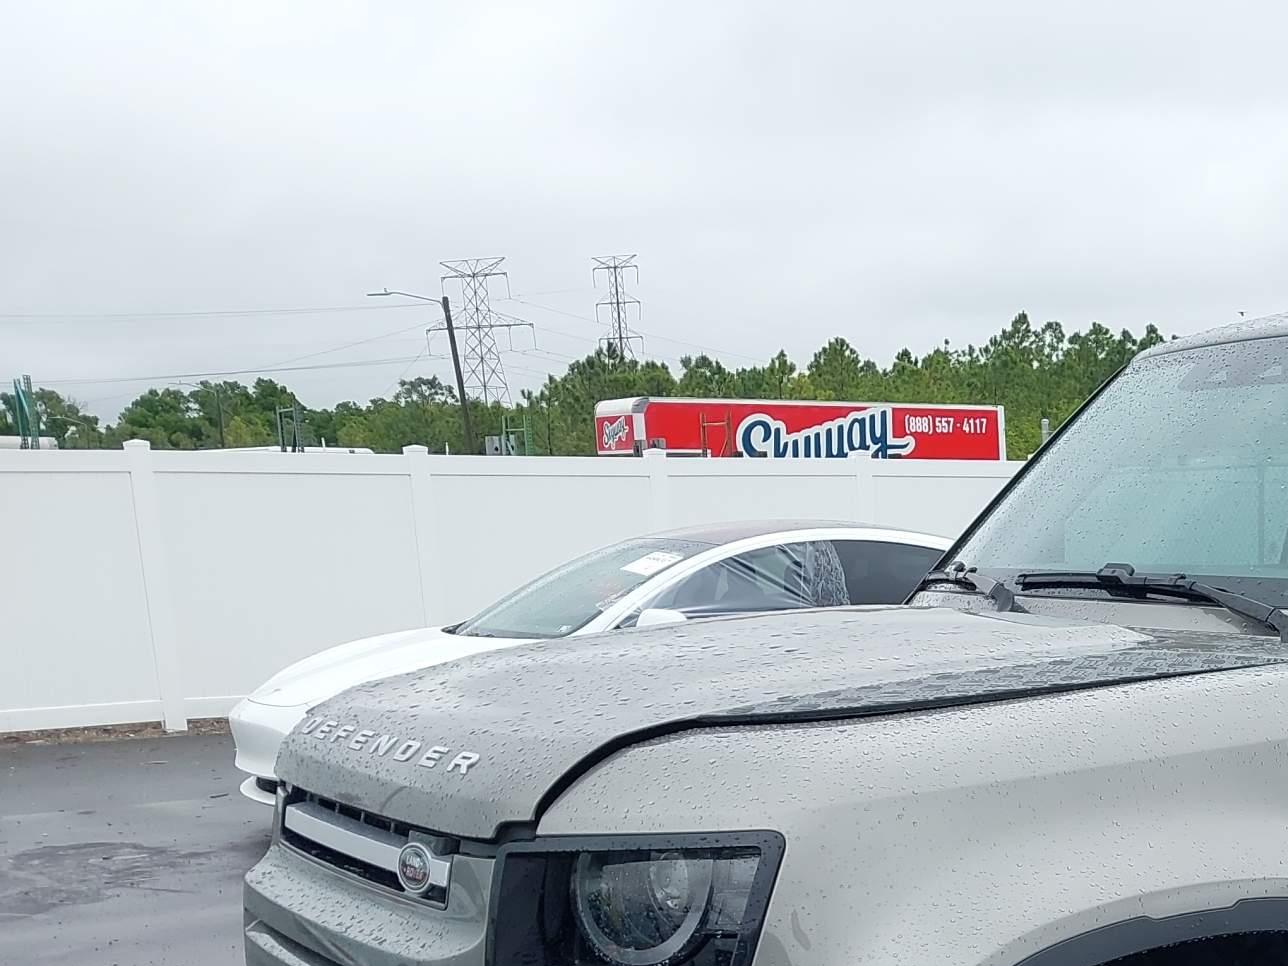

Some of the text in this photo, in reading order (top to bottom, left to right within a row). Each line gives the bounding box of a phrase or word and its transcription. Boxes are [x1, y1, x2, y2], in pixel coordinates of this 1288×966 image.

[905, 414, 933, 435] (888)
[935, 416, 954, 433] 557
[962, 417, 987, 434] 4117
[301, 716, 480, 775] DEFENDER
